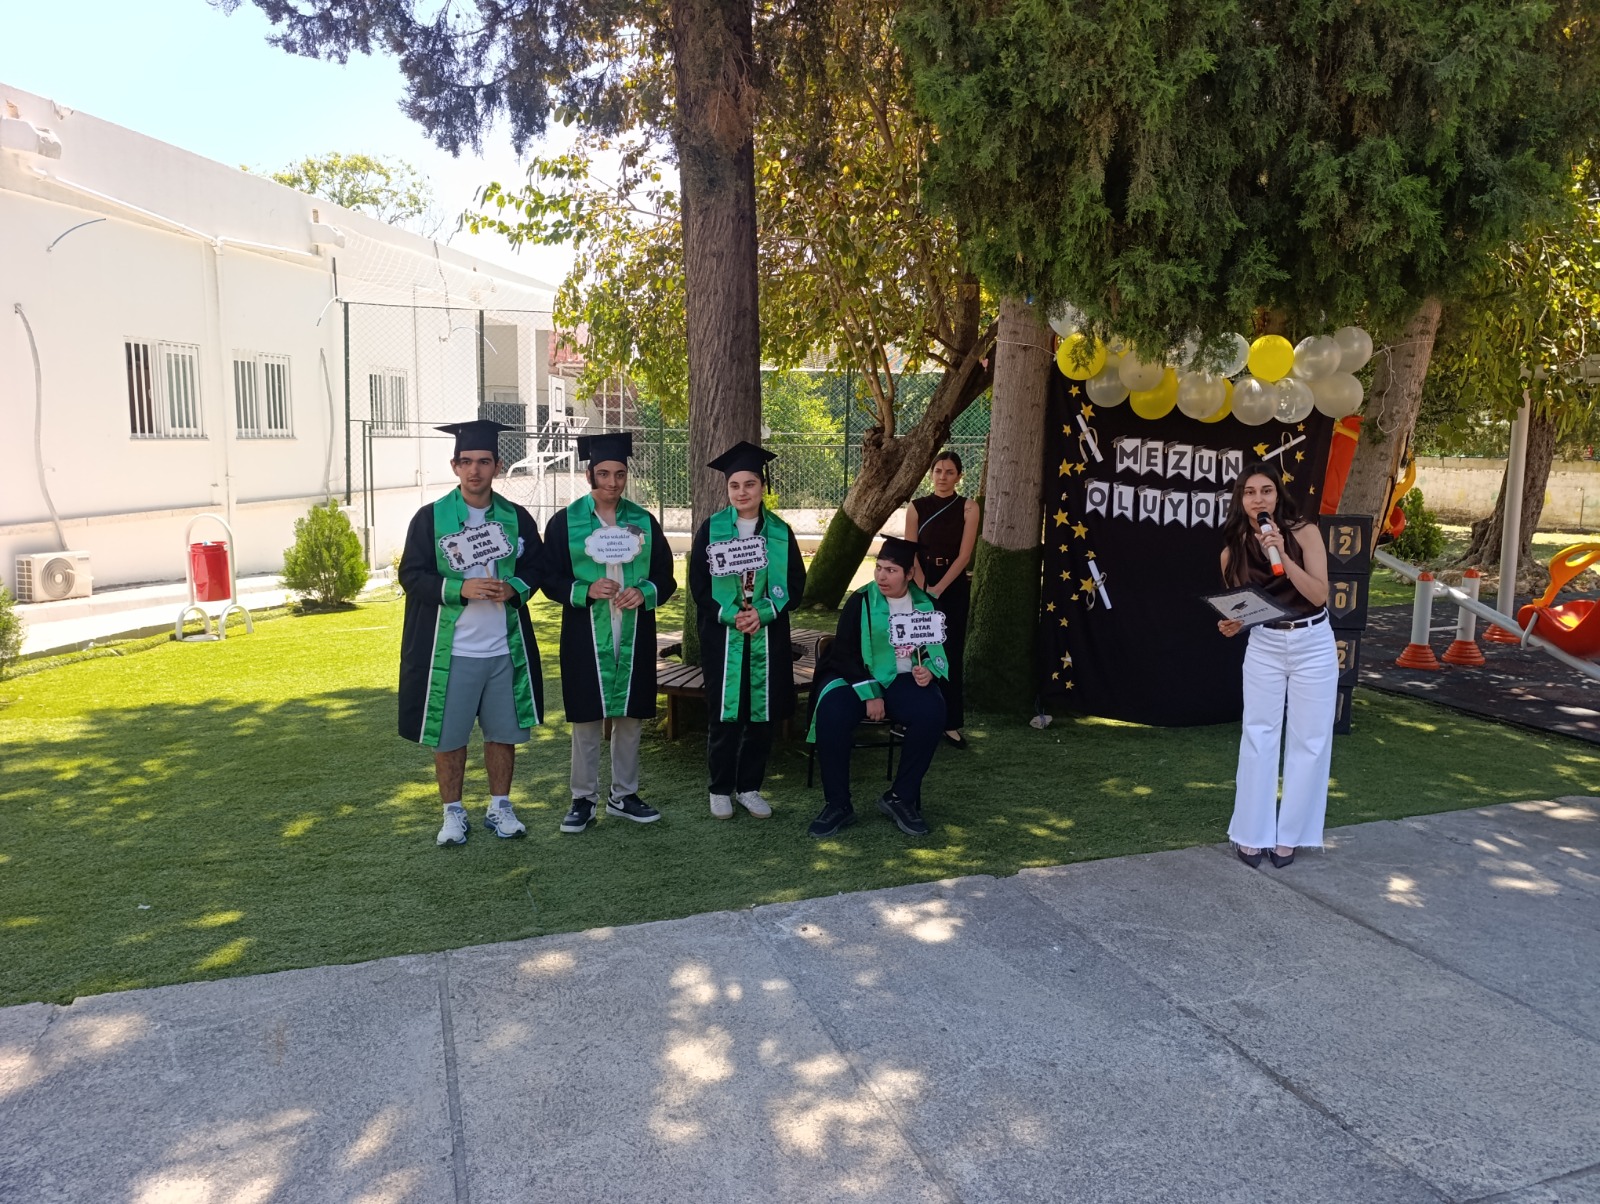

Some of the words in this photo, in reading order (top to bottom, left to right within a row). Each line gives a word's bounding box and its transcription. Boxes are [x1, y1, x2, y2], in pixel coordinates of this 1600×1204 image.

[1118, 444, 1240, 476] MEZUN
[466, 530, 491, 543] KEPİMİ
[472, 539, 493, 550] ATAR
[1338, 535, 1351, 555] 2
[472, 546, 500, 560] GİDERİM
[1334, 592, 1347, 609] 0
